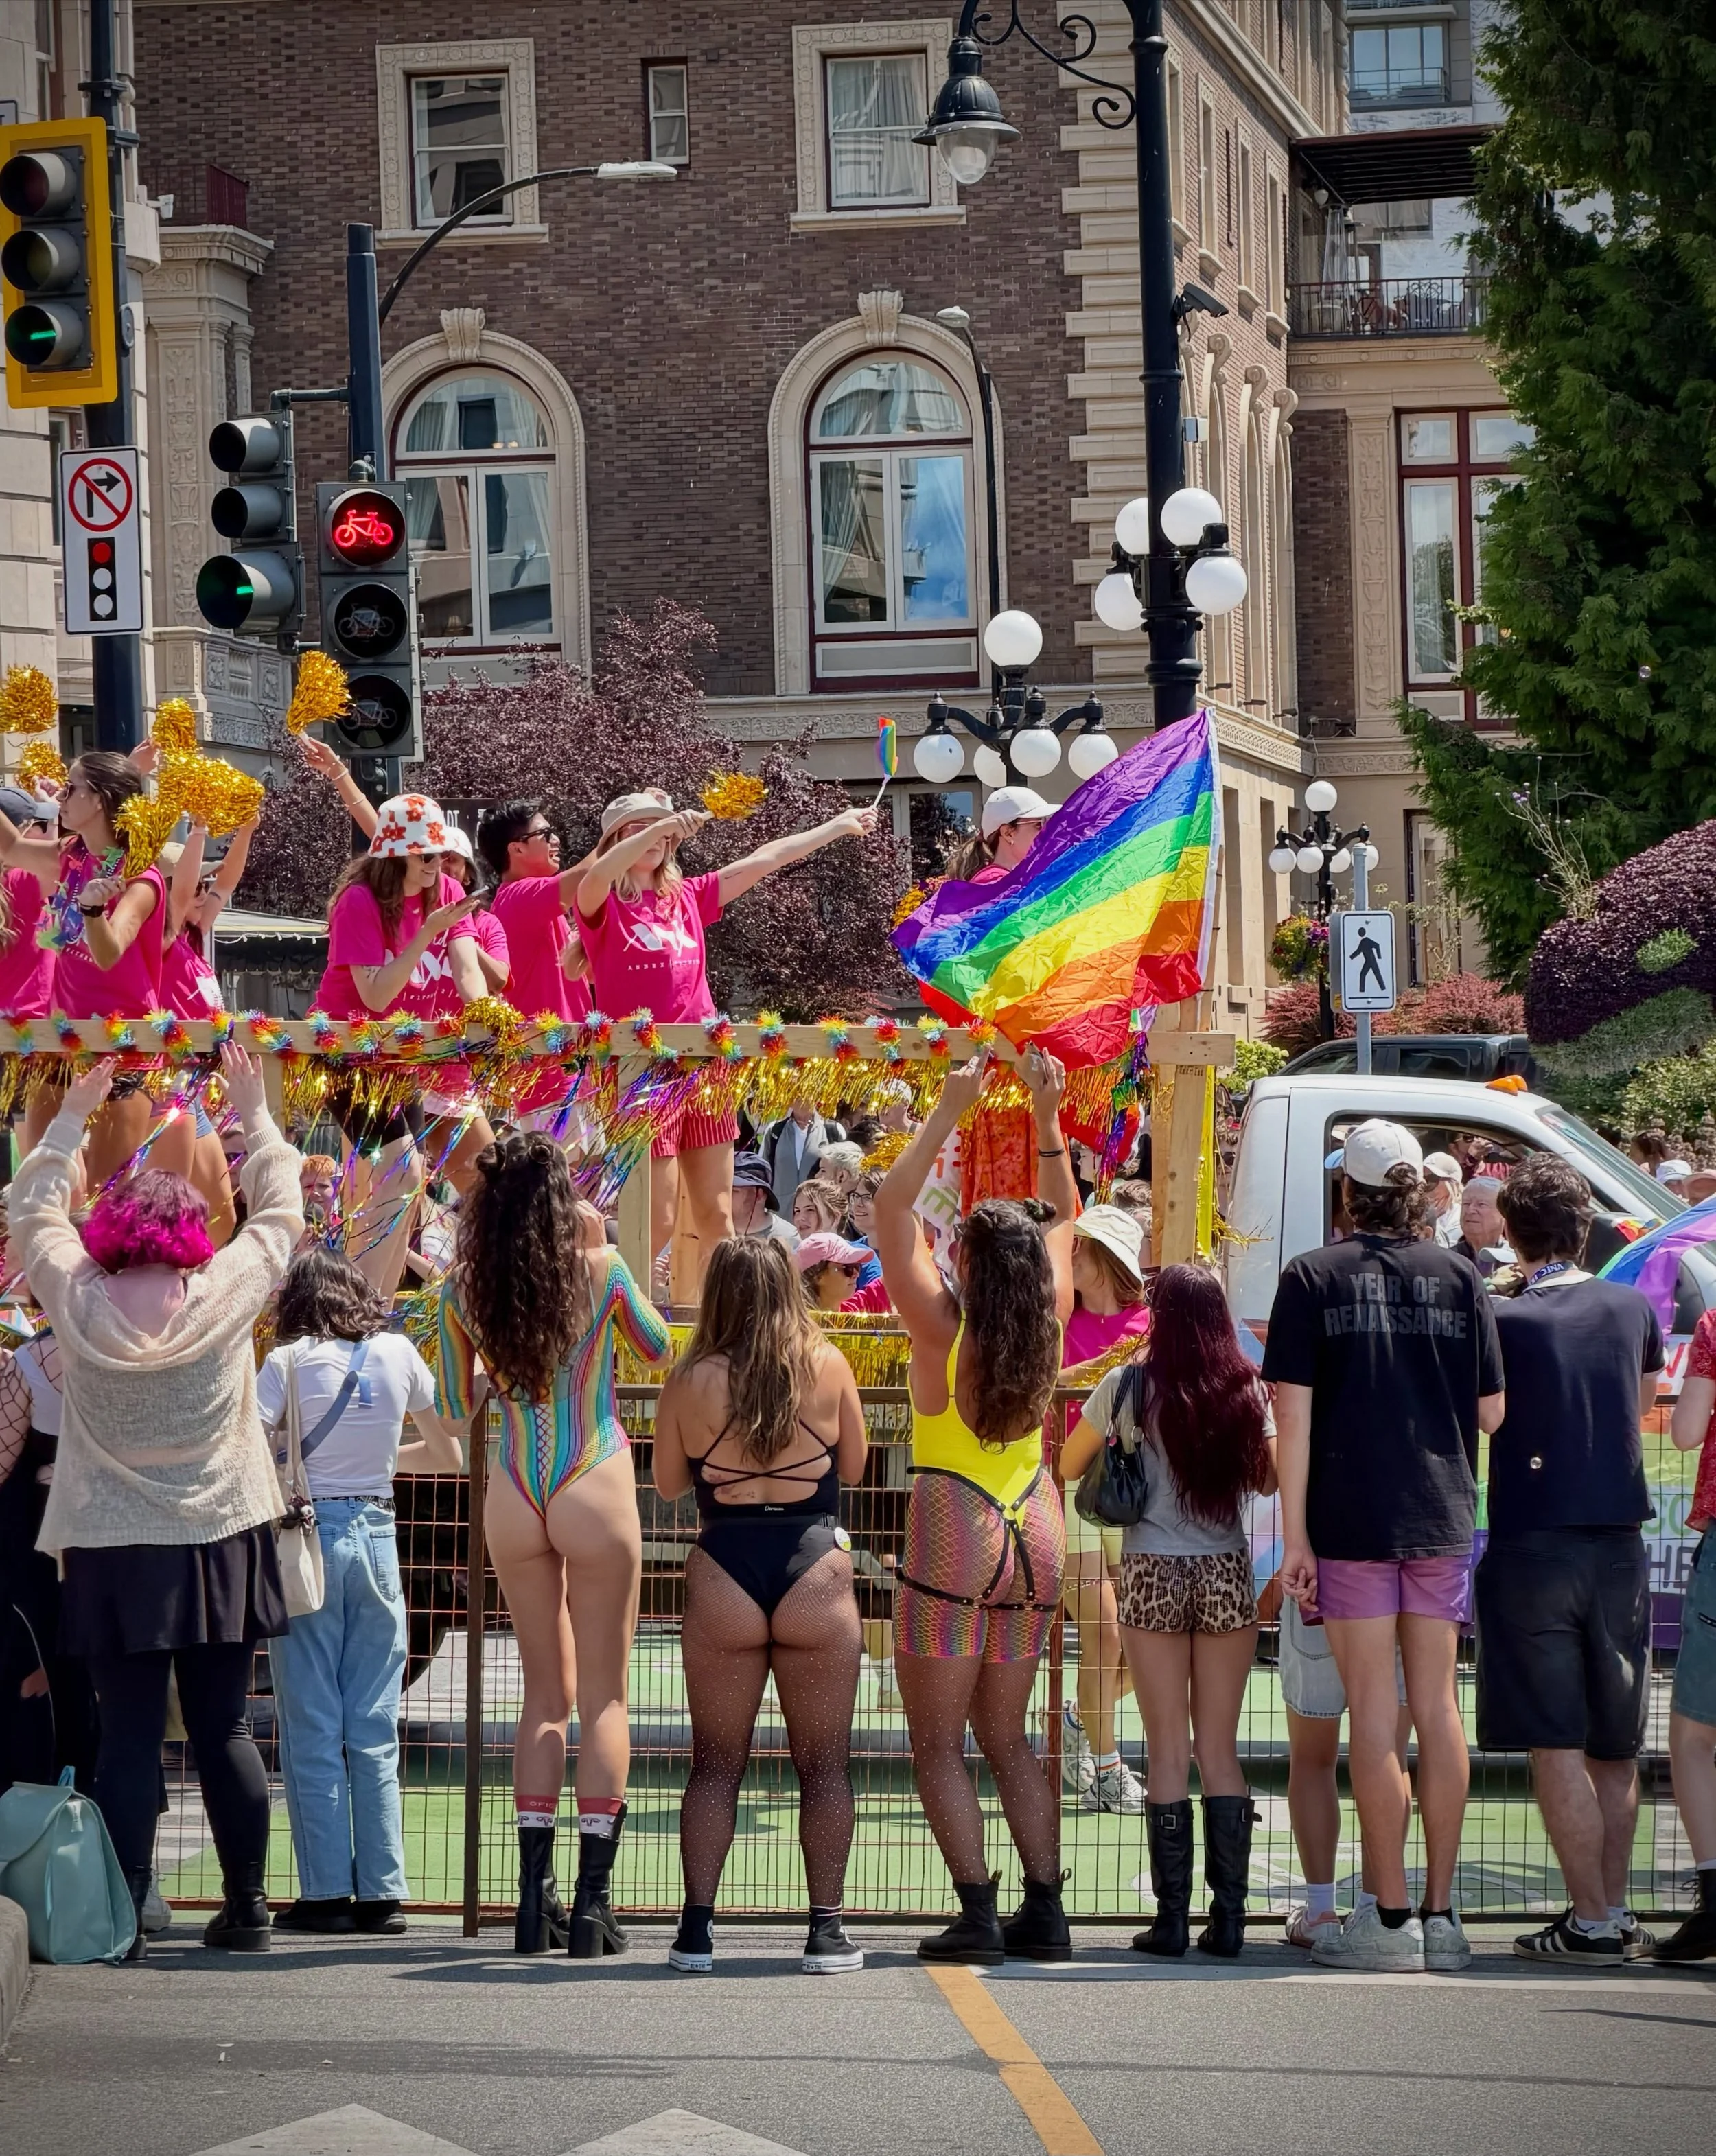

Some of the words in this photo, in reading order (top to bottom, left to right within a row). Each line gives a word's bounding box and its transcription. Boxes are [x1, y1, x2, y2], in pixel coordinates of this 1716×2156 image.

[1349, 1273, 1402, 1303] YEAR
[1413, 1275, 1440, 1304] OF
[1324, 1304, 1467, 1338] RENAISSANCE
